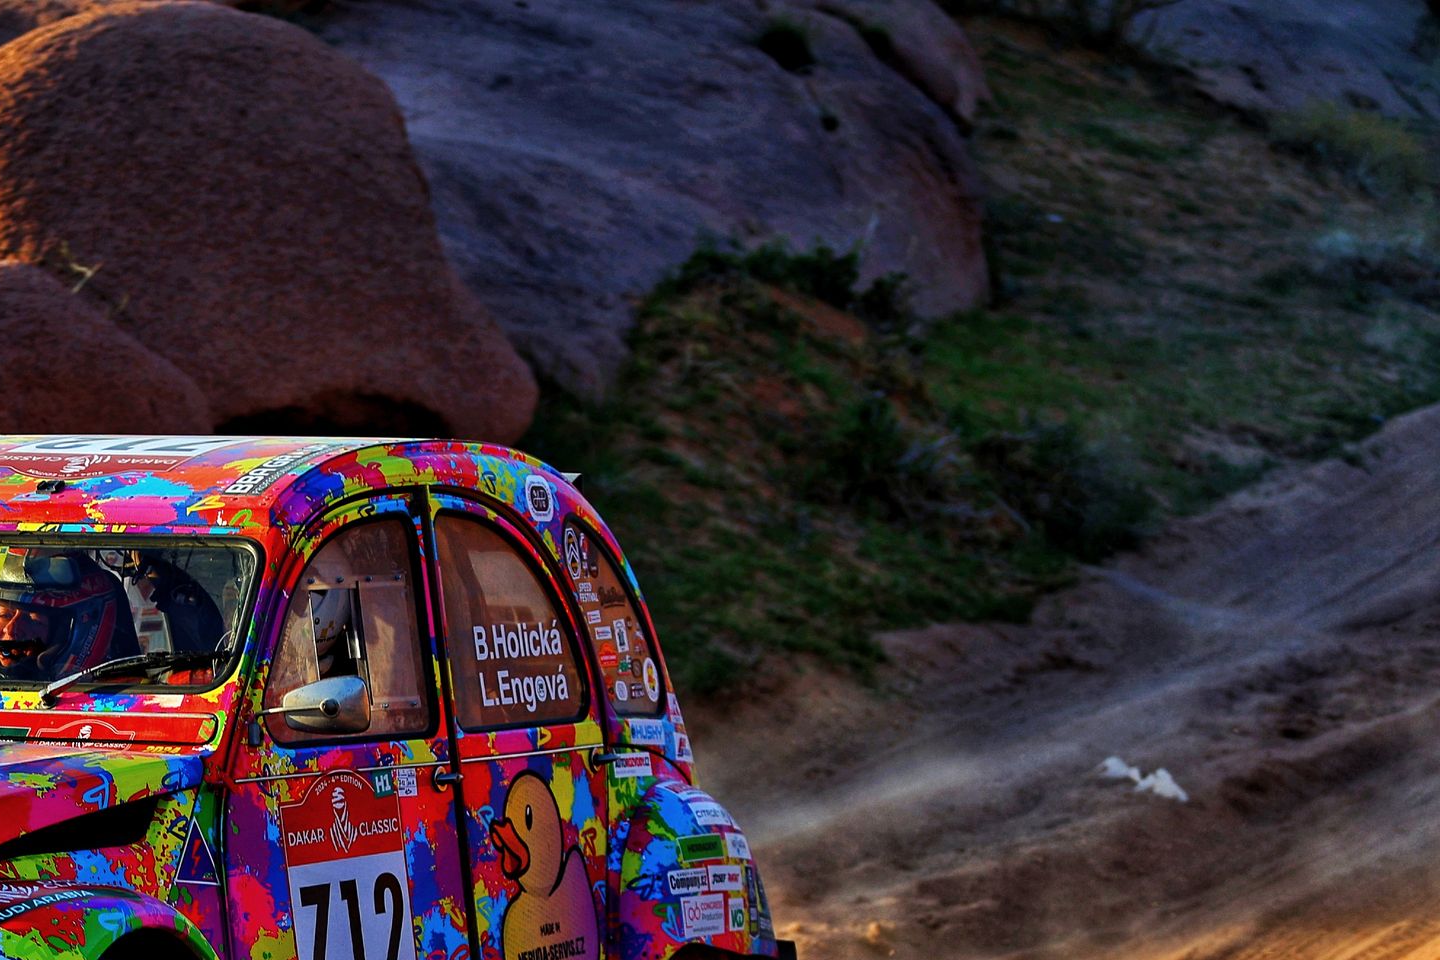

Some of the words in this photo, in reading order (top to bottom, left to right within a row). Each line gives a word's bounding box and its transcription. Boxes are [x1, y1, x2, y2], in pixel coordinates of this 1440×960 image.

[473, 619, 562, 660] B.Holická
[479, 664, 569, 712] L.Engová
[314, 780, 327, 796] 2024
[340, 775, 363, 790] EDITION
[375, 773, 392, 794] H1
[288, 828, 325, 846] DAKAR
[359, 818, 399, 836] CLASSIC
[32, 888, 95, 908] ARABIA
